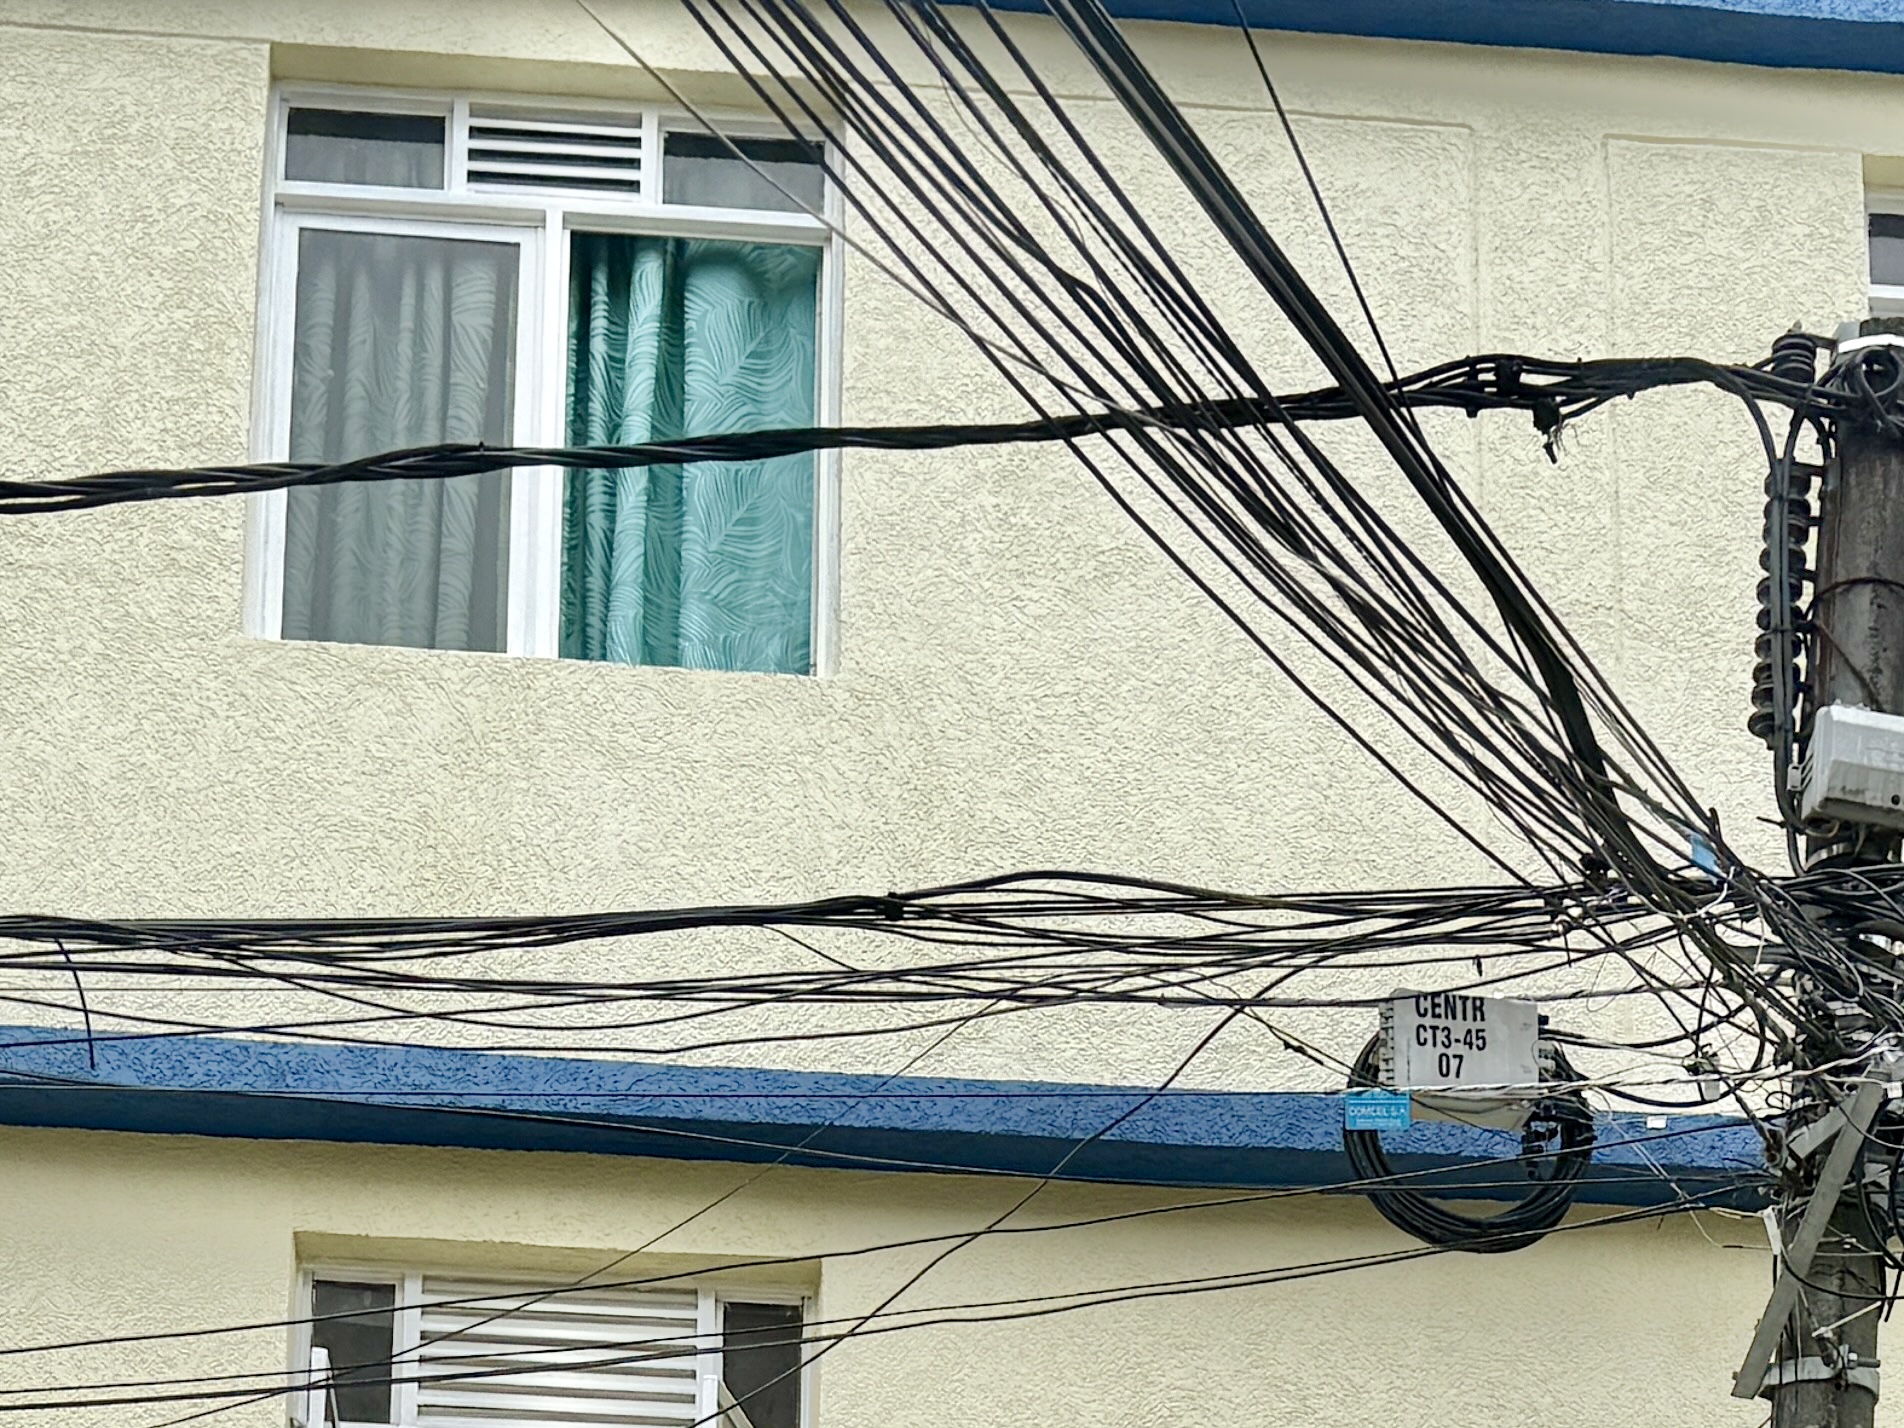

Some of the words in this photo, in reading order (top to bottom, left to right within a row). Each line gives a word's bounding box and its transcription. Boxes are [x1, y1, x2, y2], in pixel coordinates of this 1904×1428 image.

[1415, 993, 1486, 1022] CENTR
[1416, 1024, 1486, 1051] CT3-45
[1438, 1053, 1464, 1078] 07
